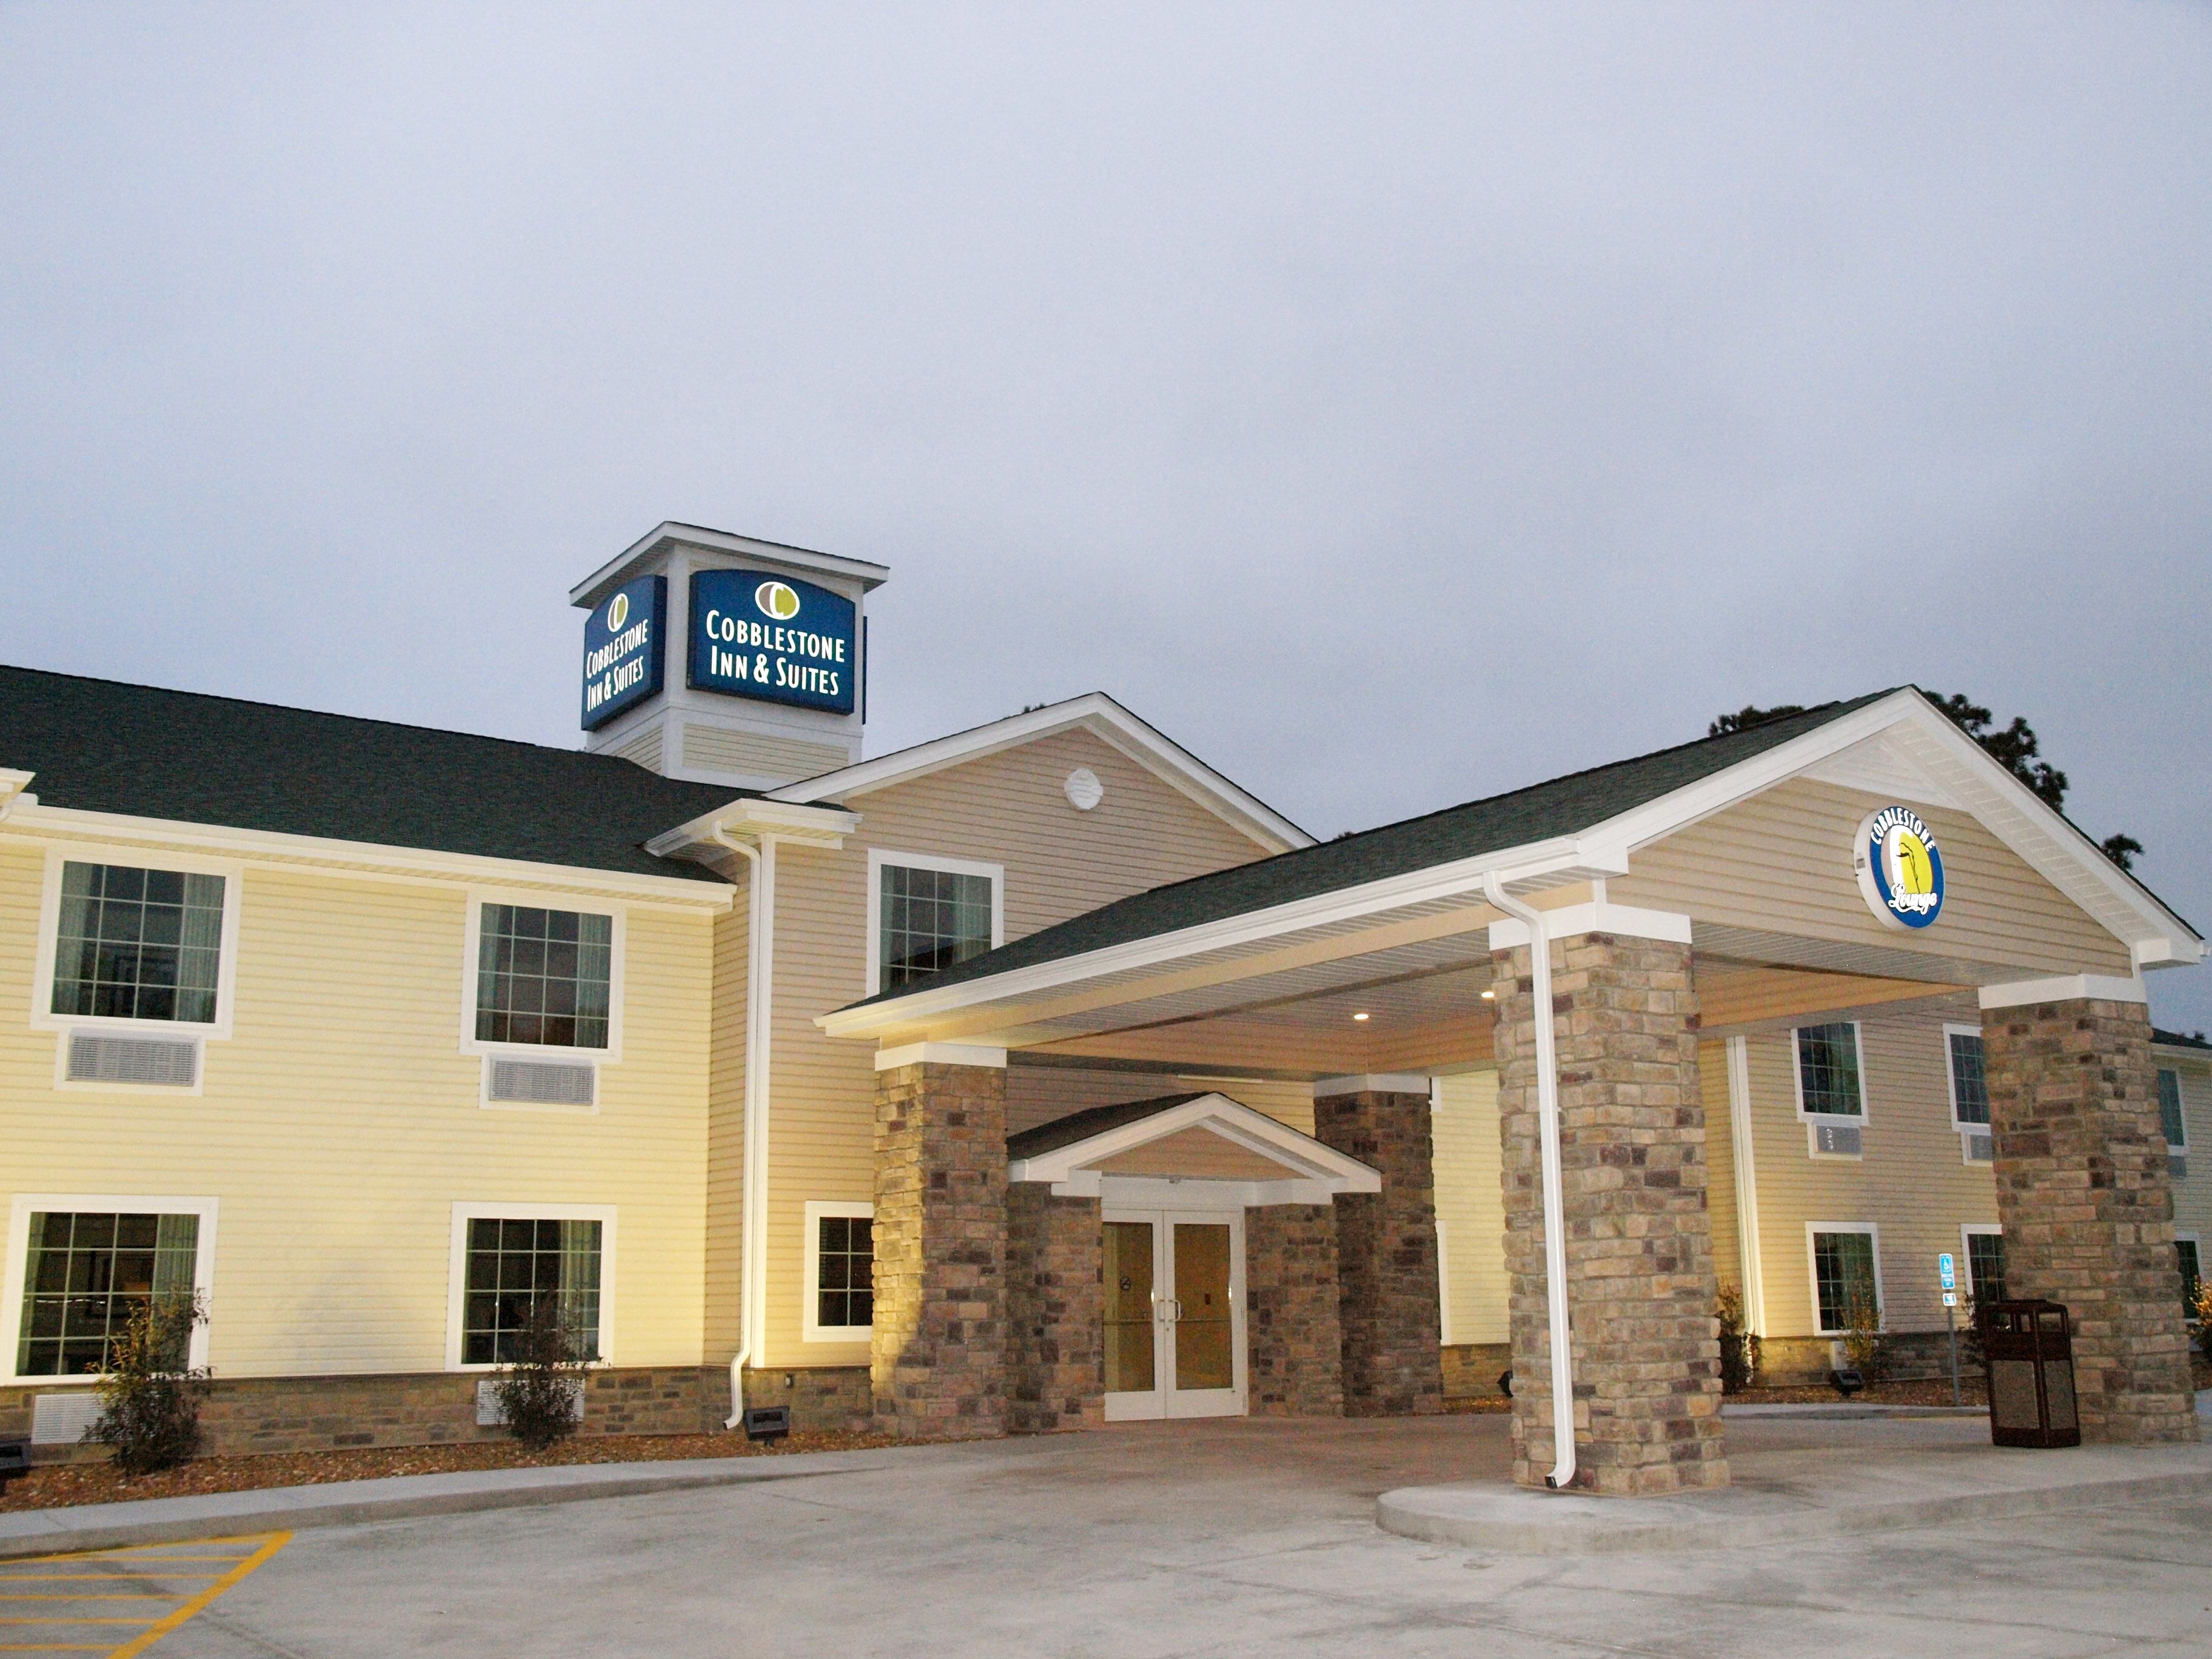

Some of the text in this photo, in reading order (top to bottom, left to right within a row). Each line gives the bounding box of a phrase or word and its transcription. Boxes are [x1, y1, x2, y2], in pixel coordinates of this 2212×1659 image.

[586, 618, 649, 679] COBBLESTONE
[706, 609, 845, 662] COBBLESTONE
[587, 655, 644, 712] INN & SUITES
[711, 645, 839, 695] INN & SUITES
[1870, 807, 1936, 852] COBBLESTONE
[1888, 883, 1937, 915] Lounge
